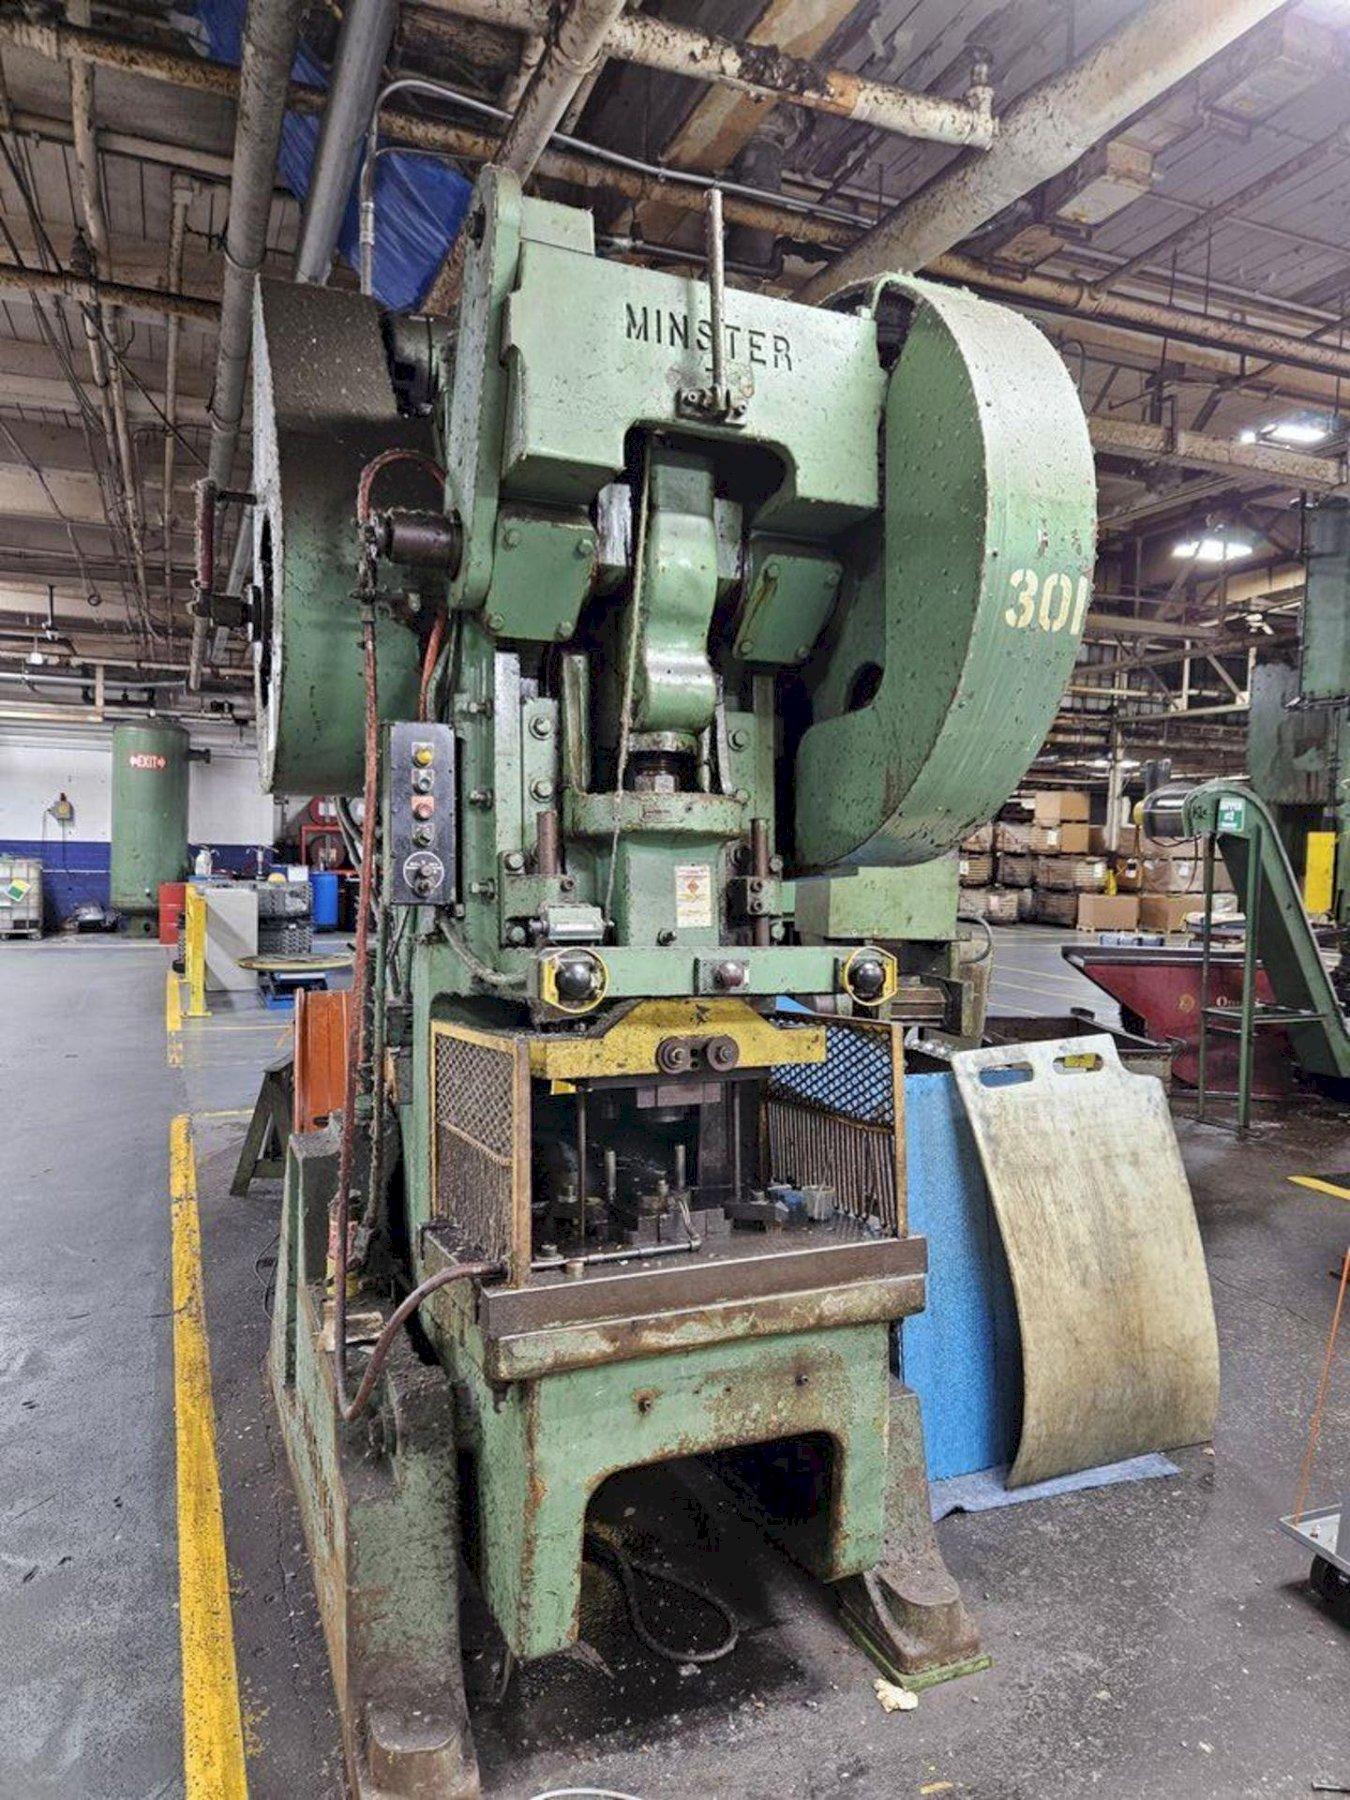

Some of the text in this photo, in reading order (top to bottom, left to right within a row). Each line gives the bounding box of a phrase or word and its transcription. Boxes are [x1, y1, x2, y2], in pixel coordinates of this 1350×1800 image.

[626, 303, 792, 371] MINSTER
[1005, 568, 1088, 635] 301
[136, 755, 158, 768] EXIT
